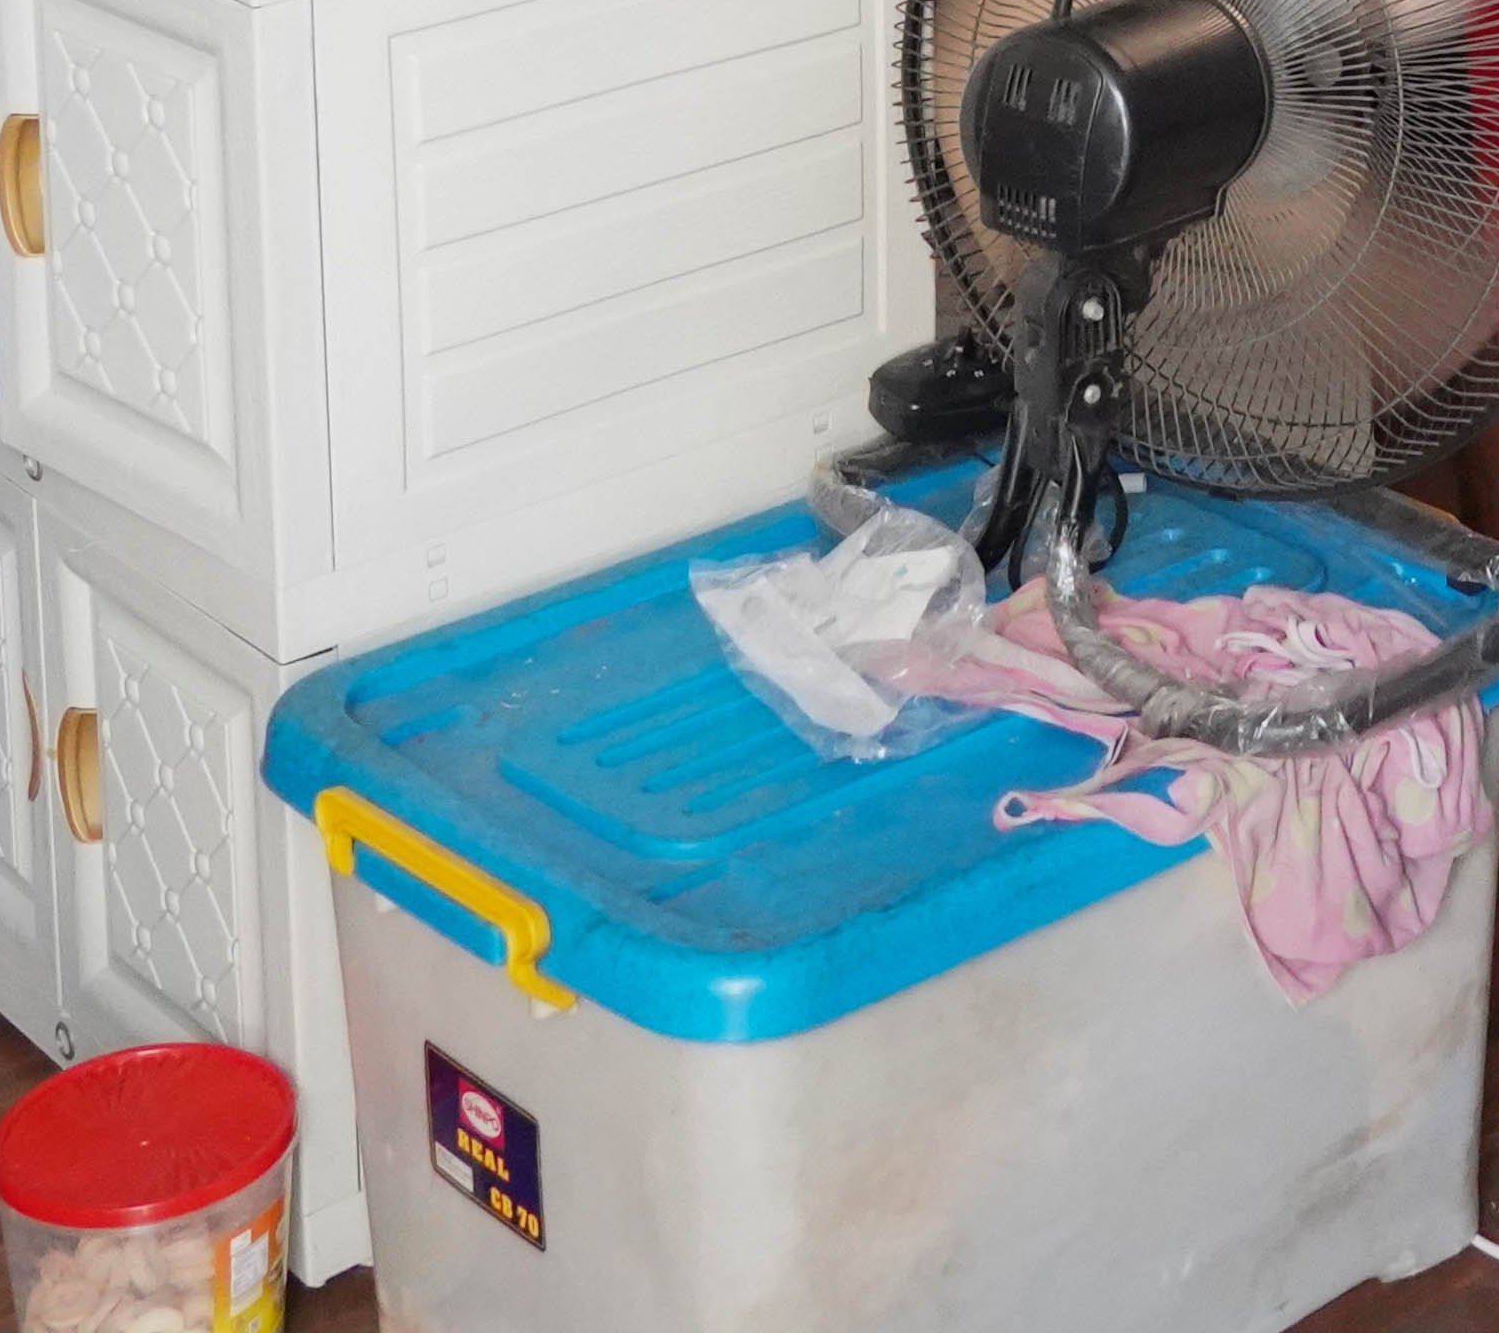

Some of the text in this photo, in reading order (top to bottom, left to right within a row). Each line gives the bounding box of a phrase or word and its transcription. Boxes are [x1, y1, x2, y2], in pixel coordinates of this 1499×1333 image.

[457, 1128, 510, 1181] REAL
[490, 1187, 540, 1238] CB 70
